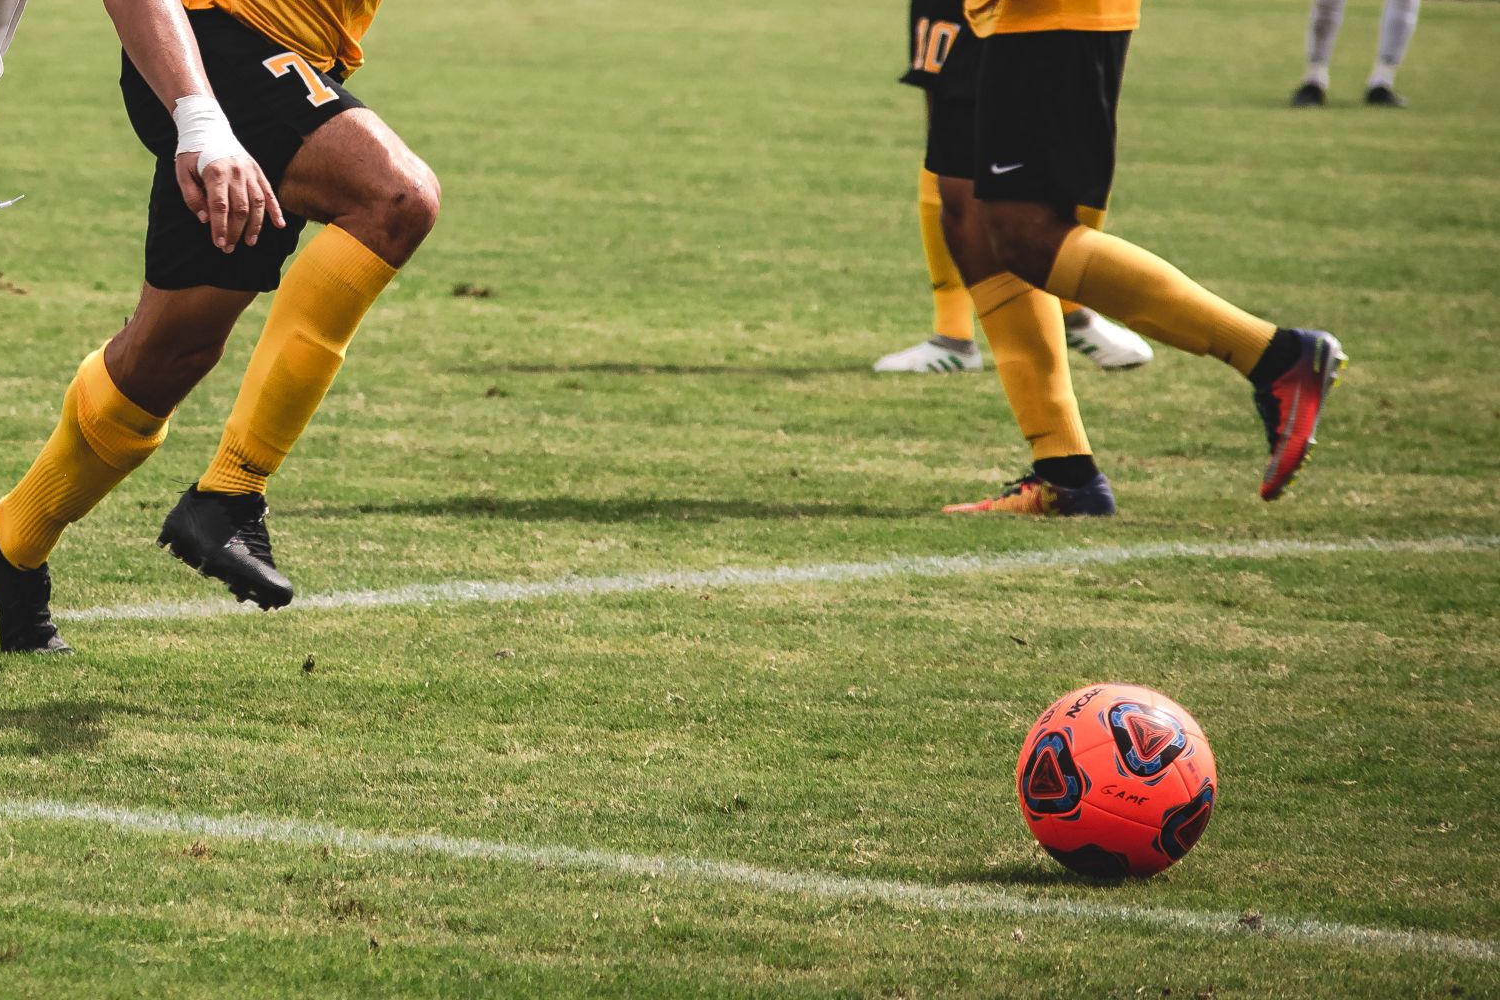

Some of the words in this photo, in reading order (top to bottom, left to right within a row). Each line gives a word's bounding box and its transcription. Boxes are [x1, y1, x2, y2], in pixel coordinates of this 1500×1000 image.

[912, 14, 961, 74] 10
[262, 51, 340, 108] 7
[1100, 784, 1150, 806] GAME
